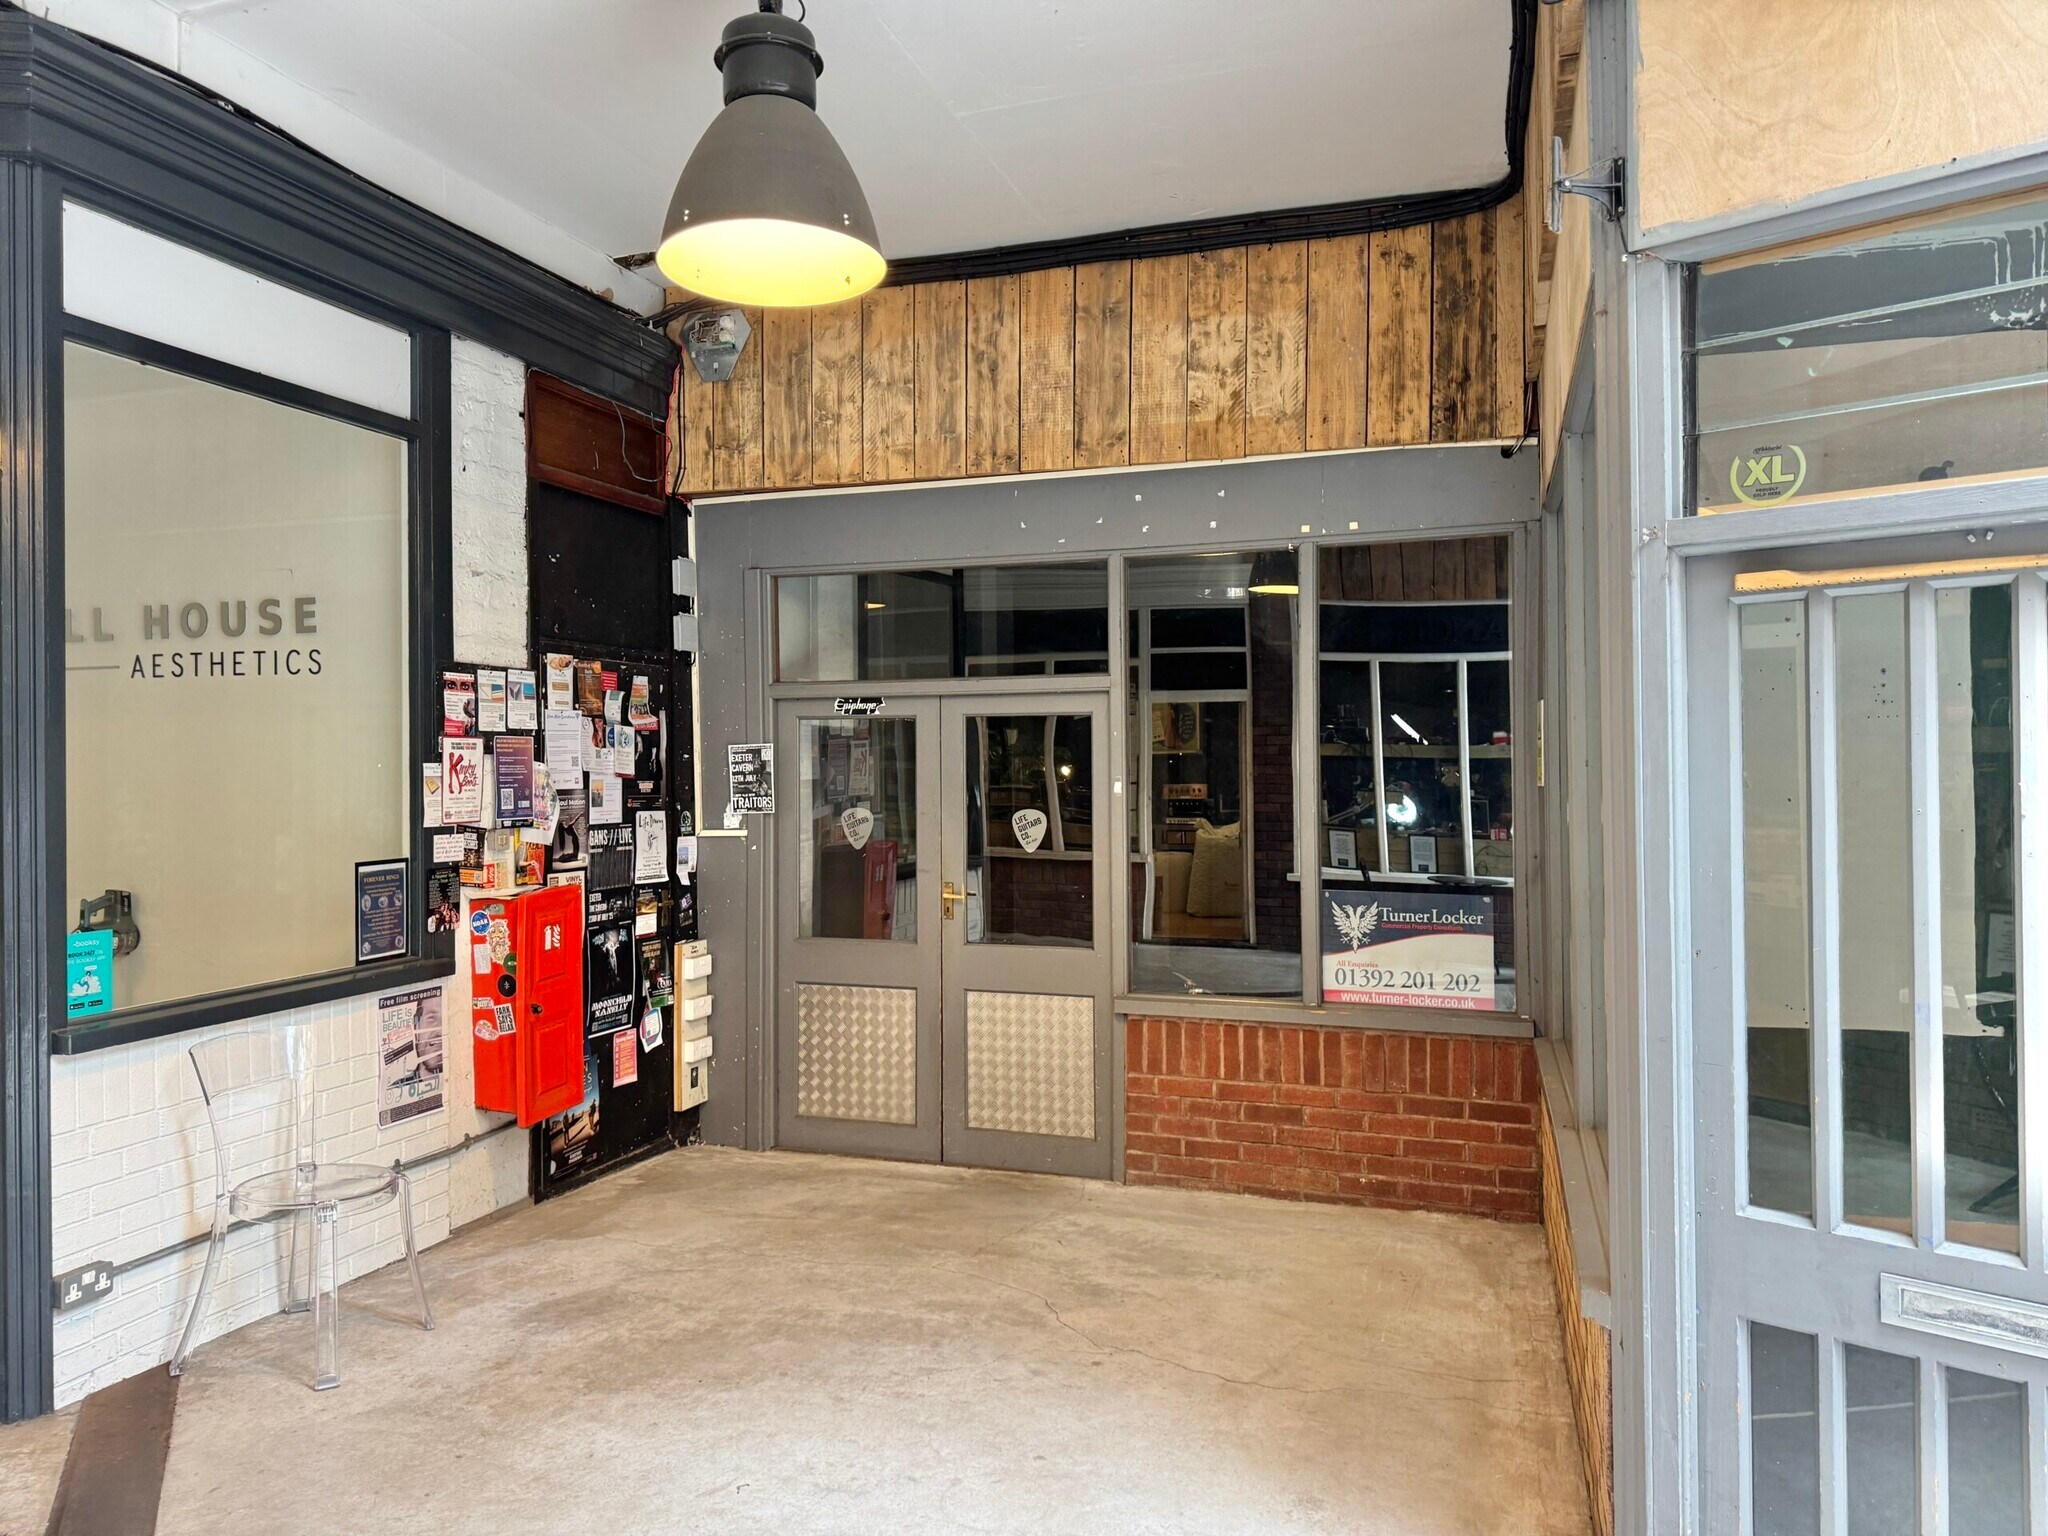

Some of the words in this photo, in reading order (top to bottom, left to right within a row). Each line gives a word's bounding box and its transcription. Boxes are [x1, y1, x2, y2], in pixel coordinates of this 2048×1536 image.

[1741, 455, 1795, 487] XL
[144, 597, 317, 640] HOUSE
[131, 649, 322, 678] AESTHETICS
[834, 697, 880, 715] Epiphone
[731, 754, 753, 762] EXETER
[731, 763, 754, 772] CAVERN
[461, 773, 479, 787] Boots
[732, 796, 772, 808] TRAITORS
[843, 812, 856, 823] LIFE
[846, 816, 869, 830] GUITARS
[1014, 813, 1028, 825] LIFE
[1017, 817, 1042, 832] GUITARS
[589, 829, 608, 846] GANS
[619, 828, 633, 844] LIVE
[1021, 832, 1032, 840] CO.
[1379, 907, 1430, 923] Turner
[1431, 908, 1484, 925] Locker
[1334, 968, 1396, 988] 01392
[1400, 971, 1435, 989] 201
[1443, 973, 1481, 992] 202
[380, 997, 395, 1007] Free
[396, 995, 409, 1004] film
[410, 988, 441, 1000] screening
[1341, 992, 1476, 1009] www.turner-locker.co.uk
[382, 1009, 403, 1024] LIFE
